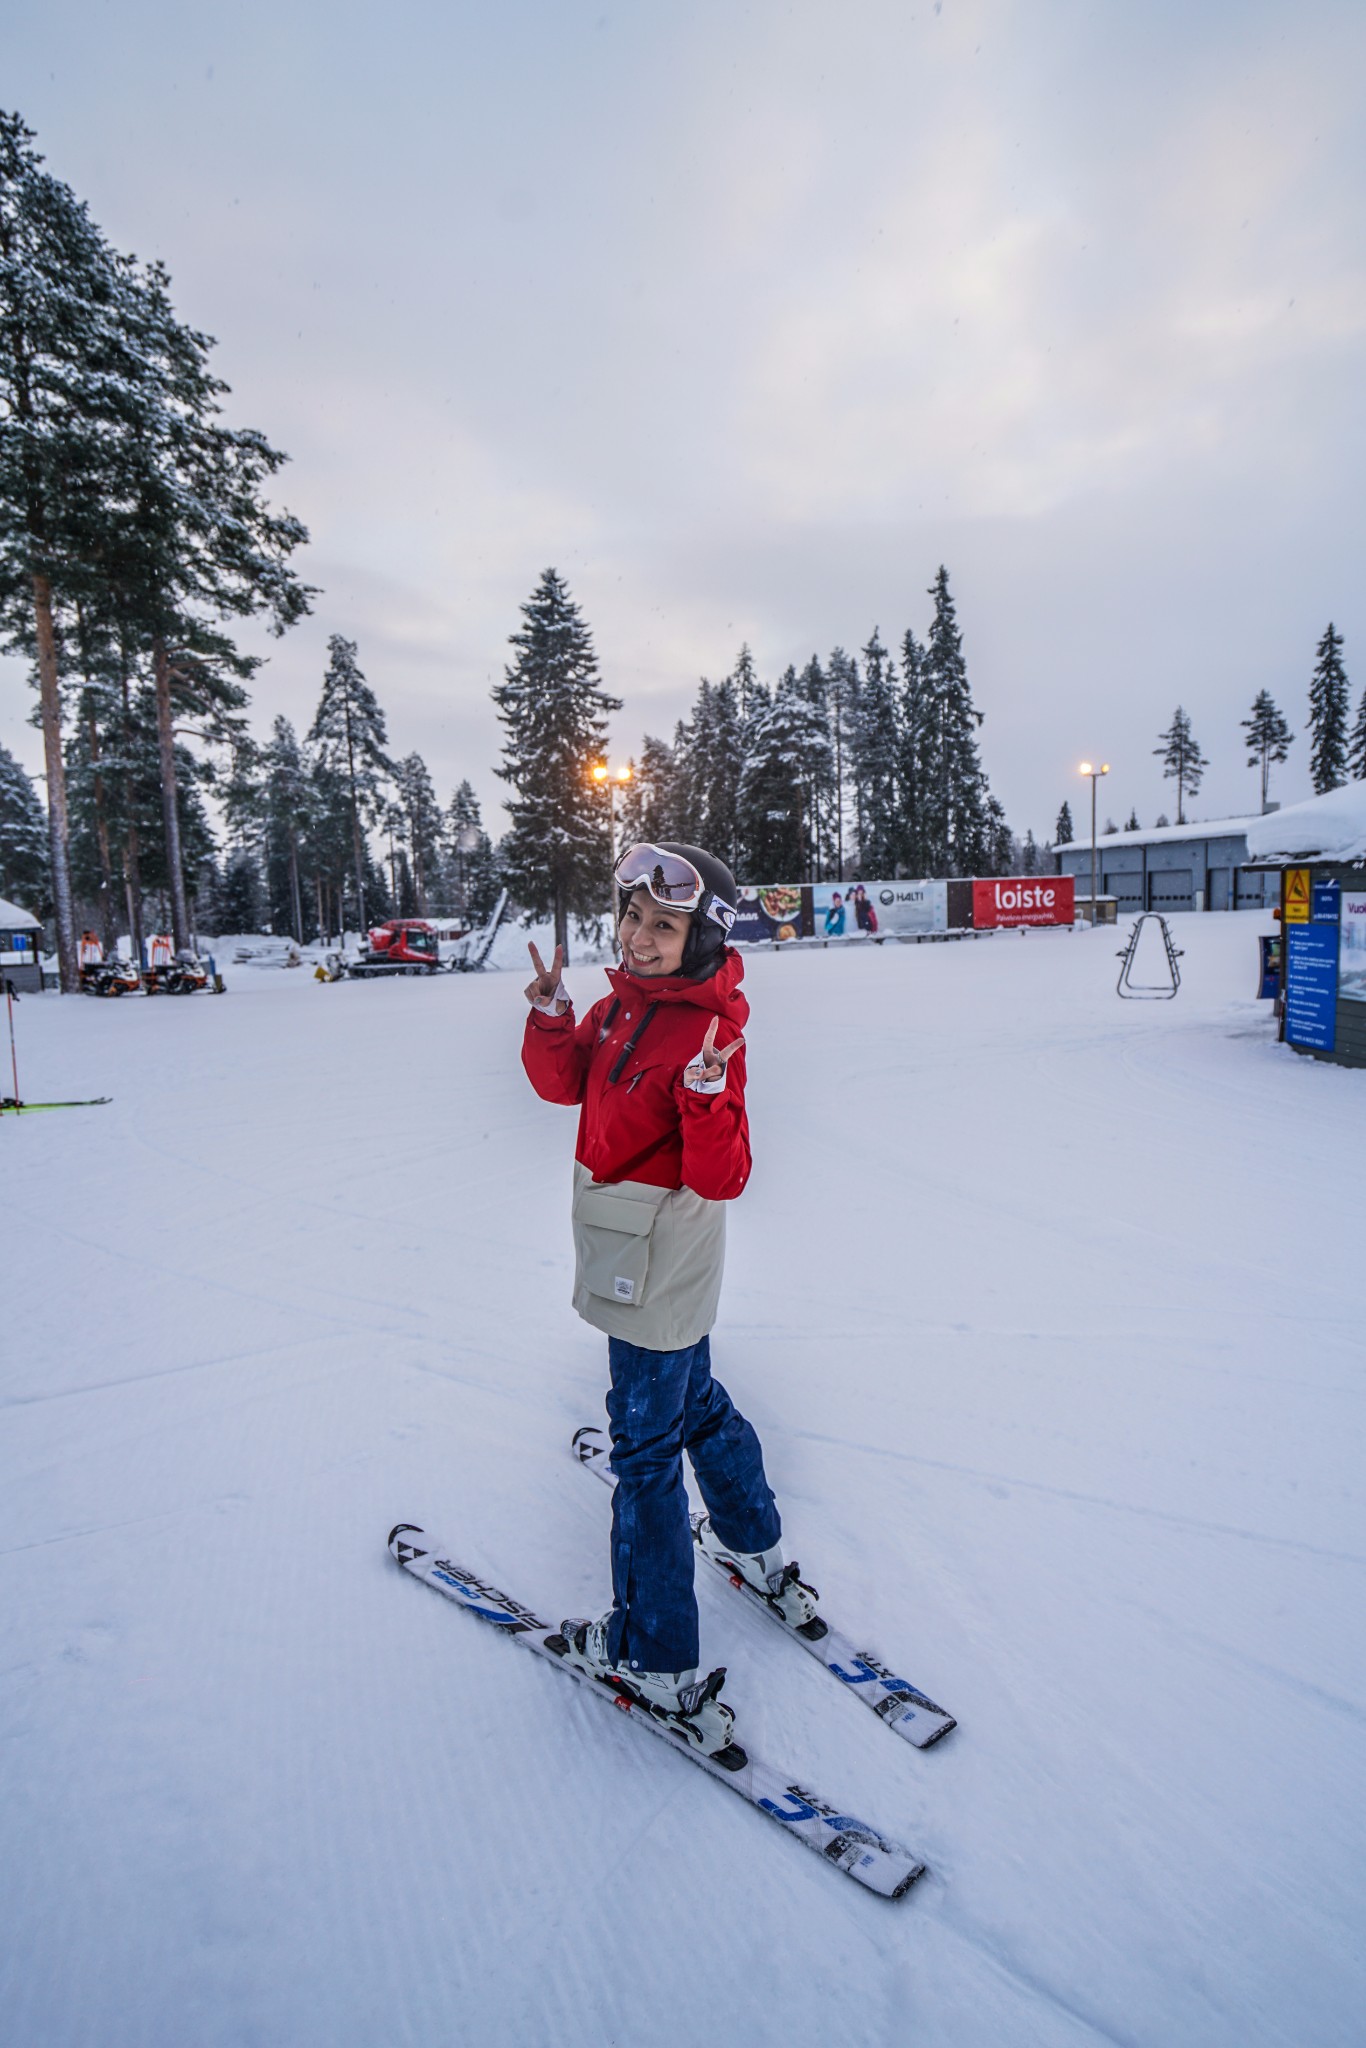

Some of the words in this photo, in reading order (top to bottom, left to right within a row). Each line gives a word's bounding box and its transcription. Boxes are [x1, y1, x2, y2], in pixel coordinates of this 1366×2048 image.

[896, 891, 924, 902] HALTI
[994, 882, 1056, 910] loiste
[434, 1559, 549, 1630] FISCHER
